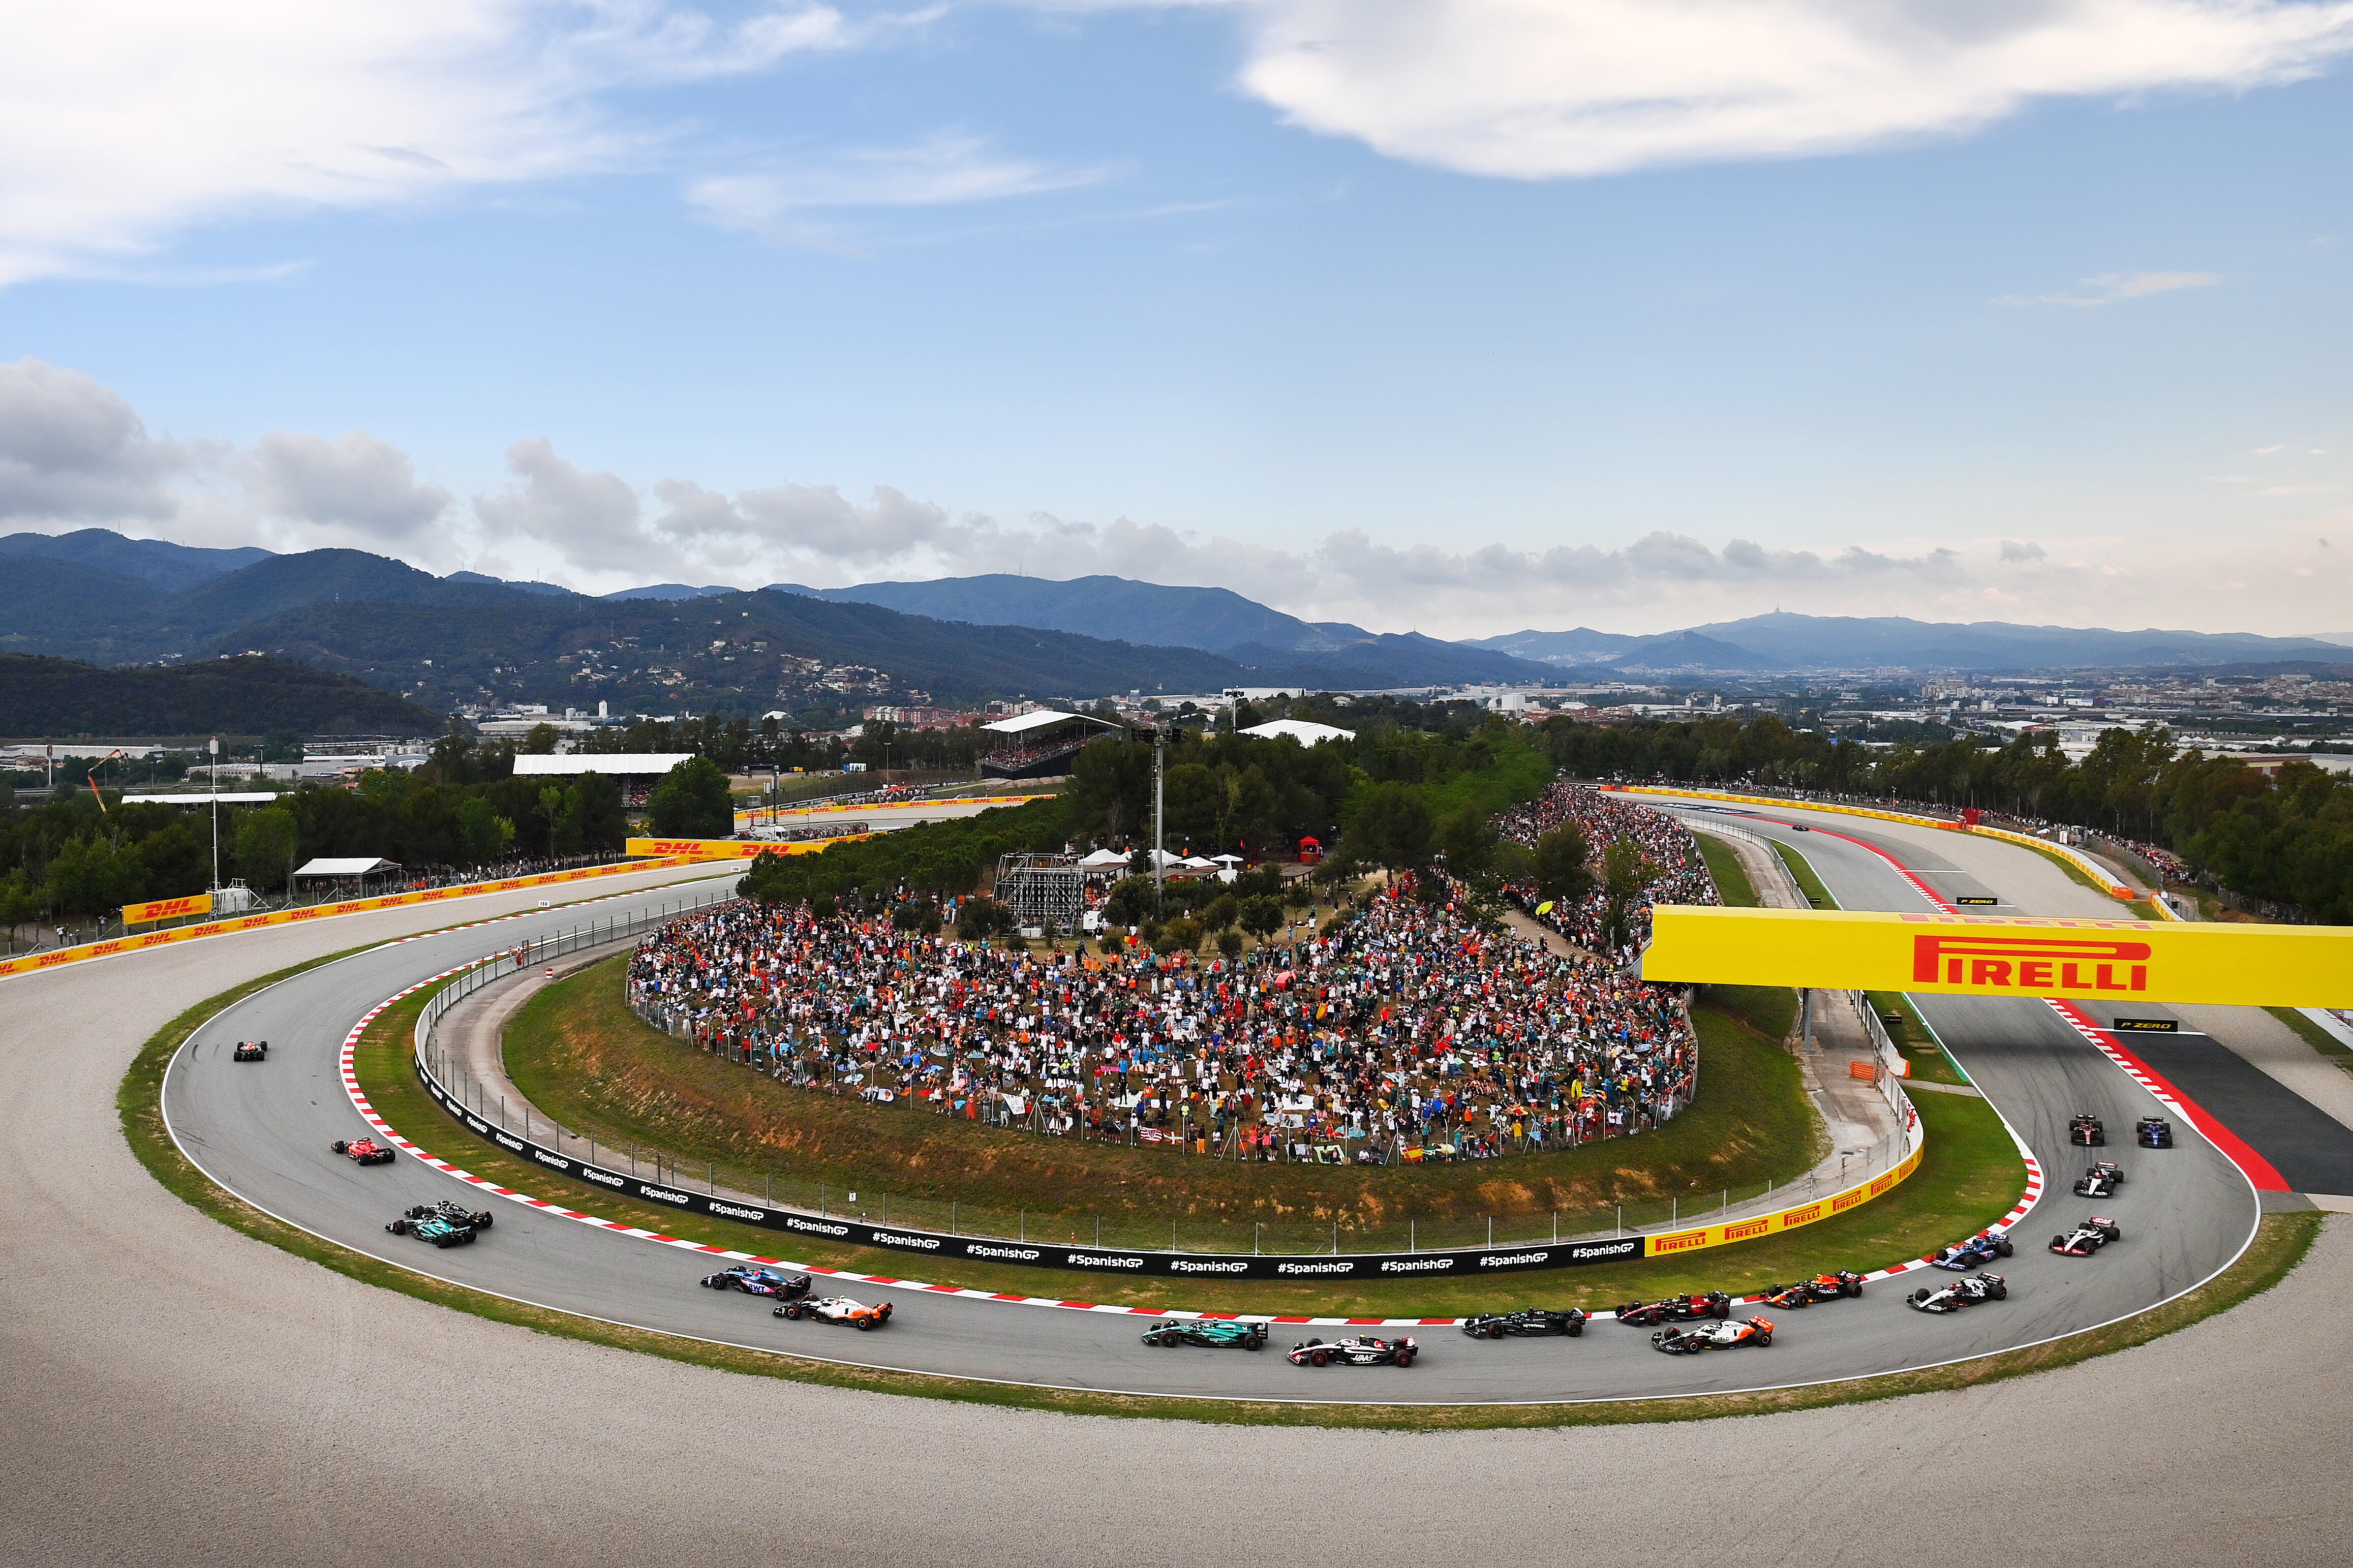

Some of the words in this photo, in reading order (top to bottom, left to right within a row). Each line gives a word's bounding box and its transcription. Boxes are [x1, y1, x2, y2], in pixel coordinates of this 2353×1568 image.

[652, 842, 705, 854] DHL
[661, 858, 677, 867] DHL
[570, 871, 588, 879] DHL
[601, 866, 619, 874] DHL
[500, 880, 521, 889] DHL
[538, 875, 556, 884] DHL
[422, 890, 444, 900] DHL
[462, 885, 483, 895] DHL
[337, 903, 361, 913] DHL
[380, 897, 403, 906] DHL
[144, 899, 193, 919] DHL
[290, 909, 316, 920] DHL
[243, 916, 269, 928] DHL
[193, 925, 221, 936] DHL
[143, 933, 171, 945] DHL
[93, 942, 121, 956] DHL
[39, 952, 68, 966] DHL
[1913, 935, 2152, 991] PIRELLI
[0, 963, 15, 974] HL
[496, 1132, 523, 1151] #SpanishGP
[535, 1150, 568, 1169] #SpanishGP
[1899, 1158, 1914, 1180] PIRELLI
[583, 1168, 624, 1187] #SpanishGP
[1871, 1174, 1892, 1196] PIRELLI
[640, 1185, 688, 1204] #SpanishGP
[1833, 1190, 1861, 1212] PIRELLI
[709, 1202, 763, 1220] #SpanishGP
[1784, 1205, 1820, 1226] PIRELLI
[787, 1218, 848, 1236] #SpanishGP
[1725, 1219, 1768, 1240] PIRELLI
[873, 1232, 940, 1249] #SpanishGP
[1656, 1232, 1706, 1252] PIRELLI
[967, 1244, 1040, 1260] #SpanishGP
[1572, 1243, 1634, 1258] #SpanishGP
[1068, 1254, 1143, 1268] #SpanishGP
[1171, 1261, 1247, 1272] #SpanishGP
[1381, 1259, 1453, 1272] #SpanishGP
[1480, 1252, 1548, 1267] #SpanishGP
[1278, 1263, 1353, 1274] #SpanishGP
[749, 1283, 766, 1293] BWT
[1350, 1354, 1377, 1362] HAAS
